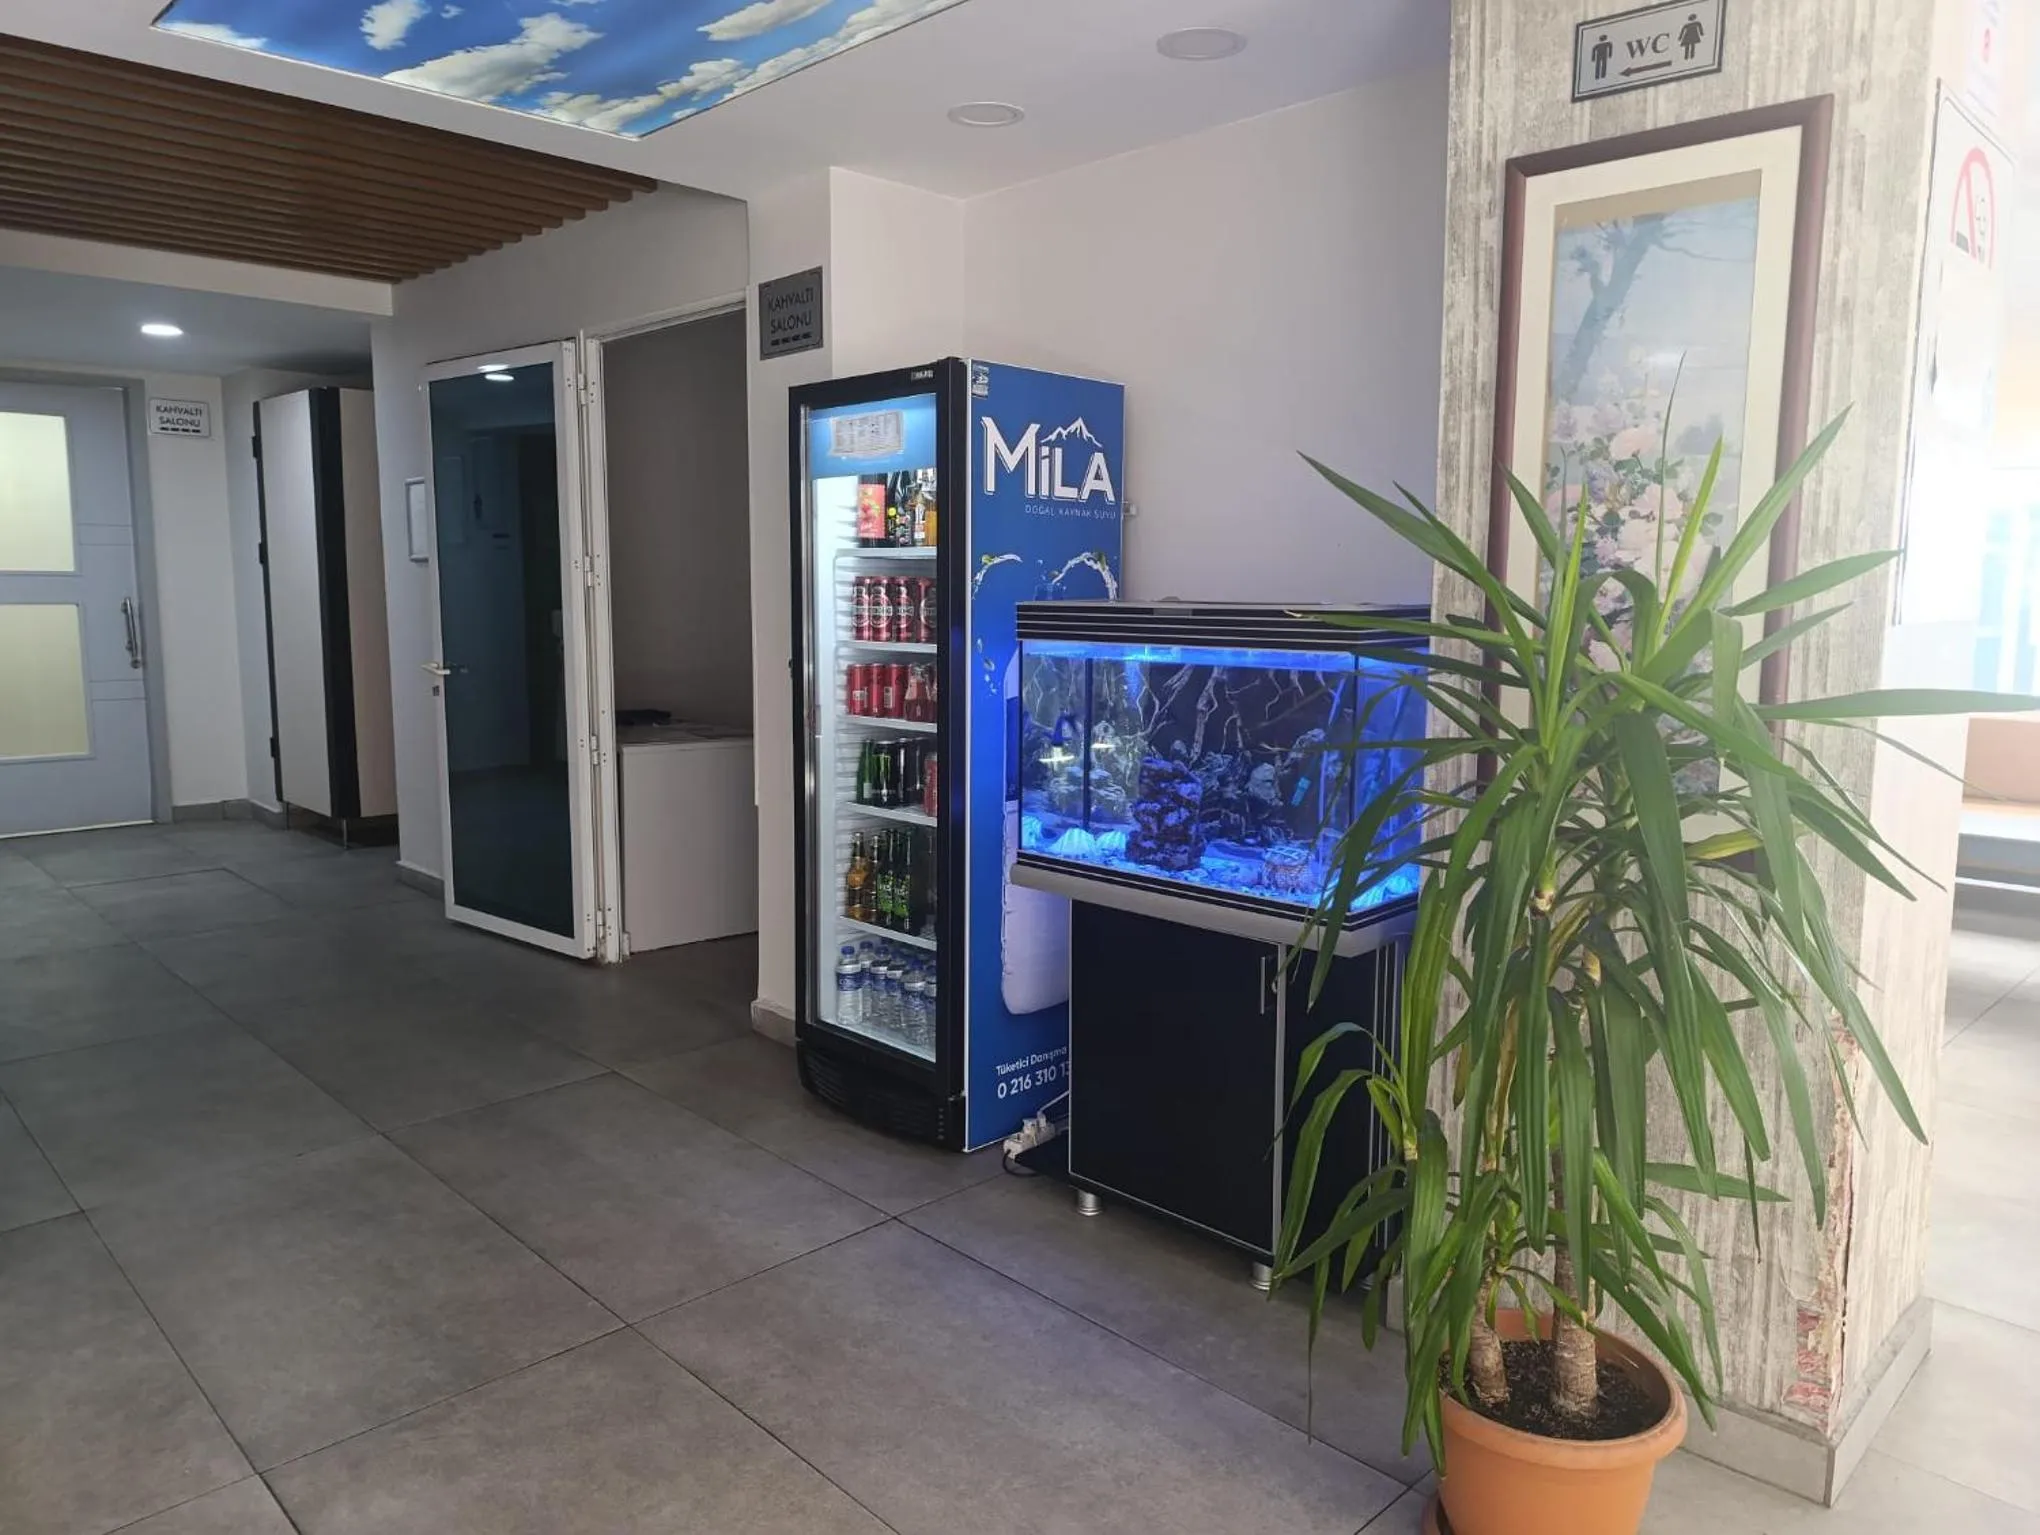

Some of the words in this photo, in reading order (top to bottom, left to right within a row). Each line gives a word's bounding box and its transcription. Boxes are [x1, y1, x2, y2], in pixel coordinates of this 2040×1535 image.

[1626, 32, 1670, 59] WC
[771, 310, 812, 334] SALONU
[996, 1055, 1029, 1076] Tüketici
[997, 1082, 1007, 1099] 0
[1010, 1074, 1032, 1096] 216
[1035, 1065, 1056, 1085] 310
